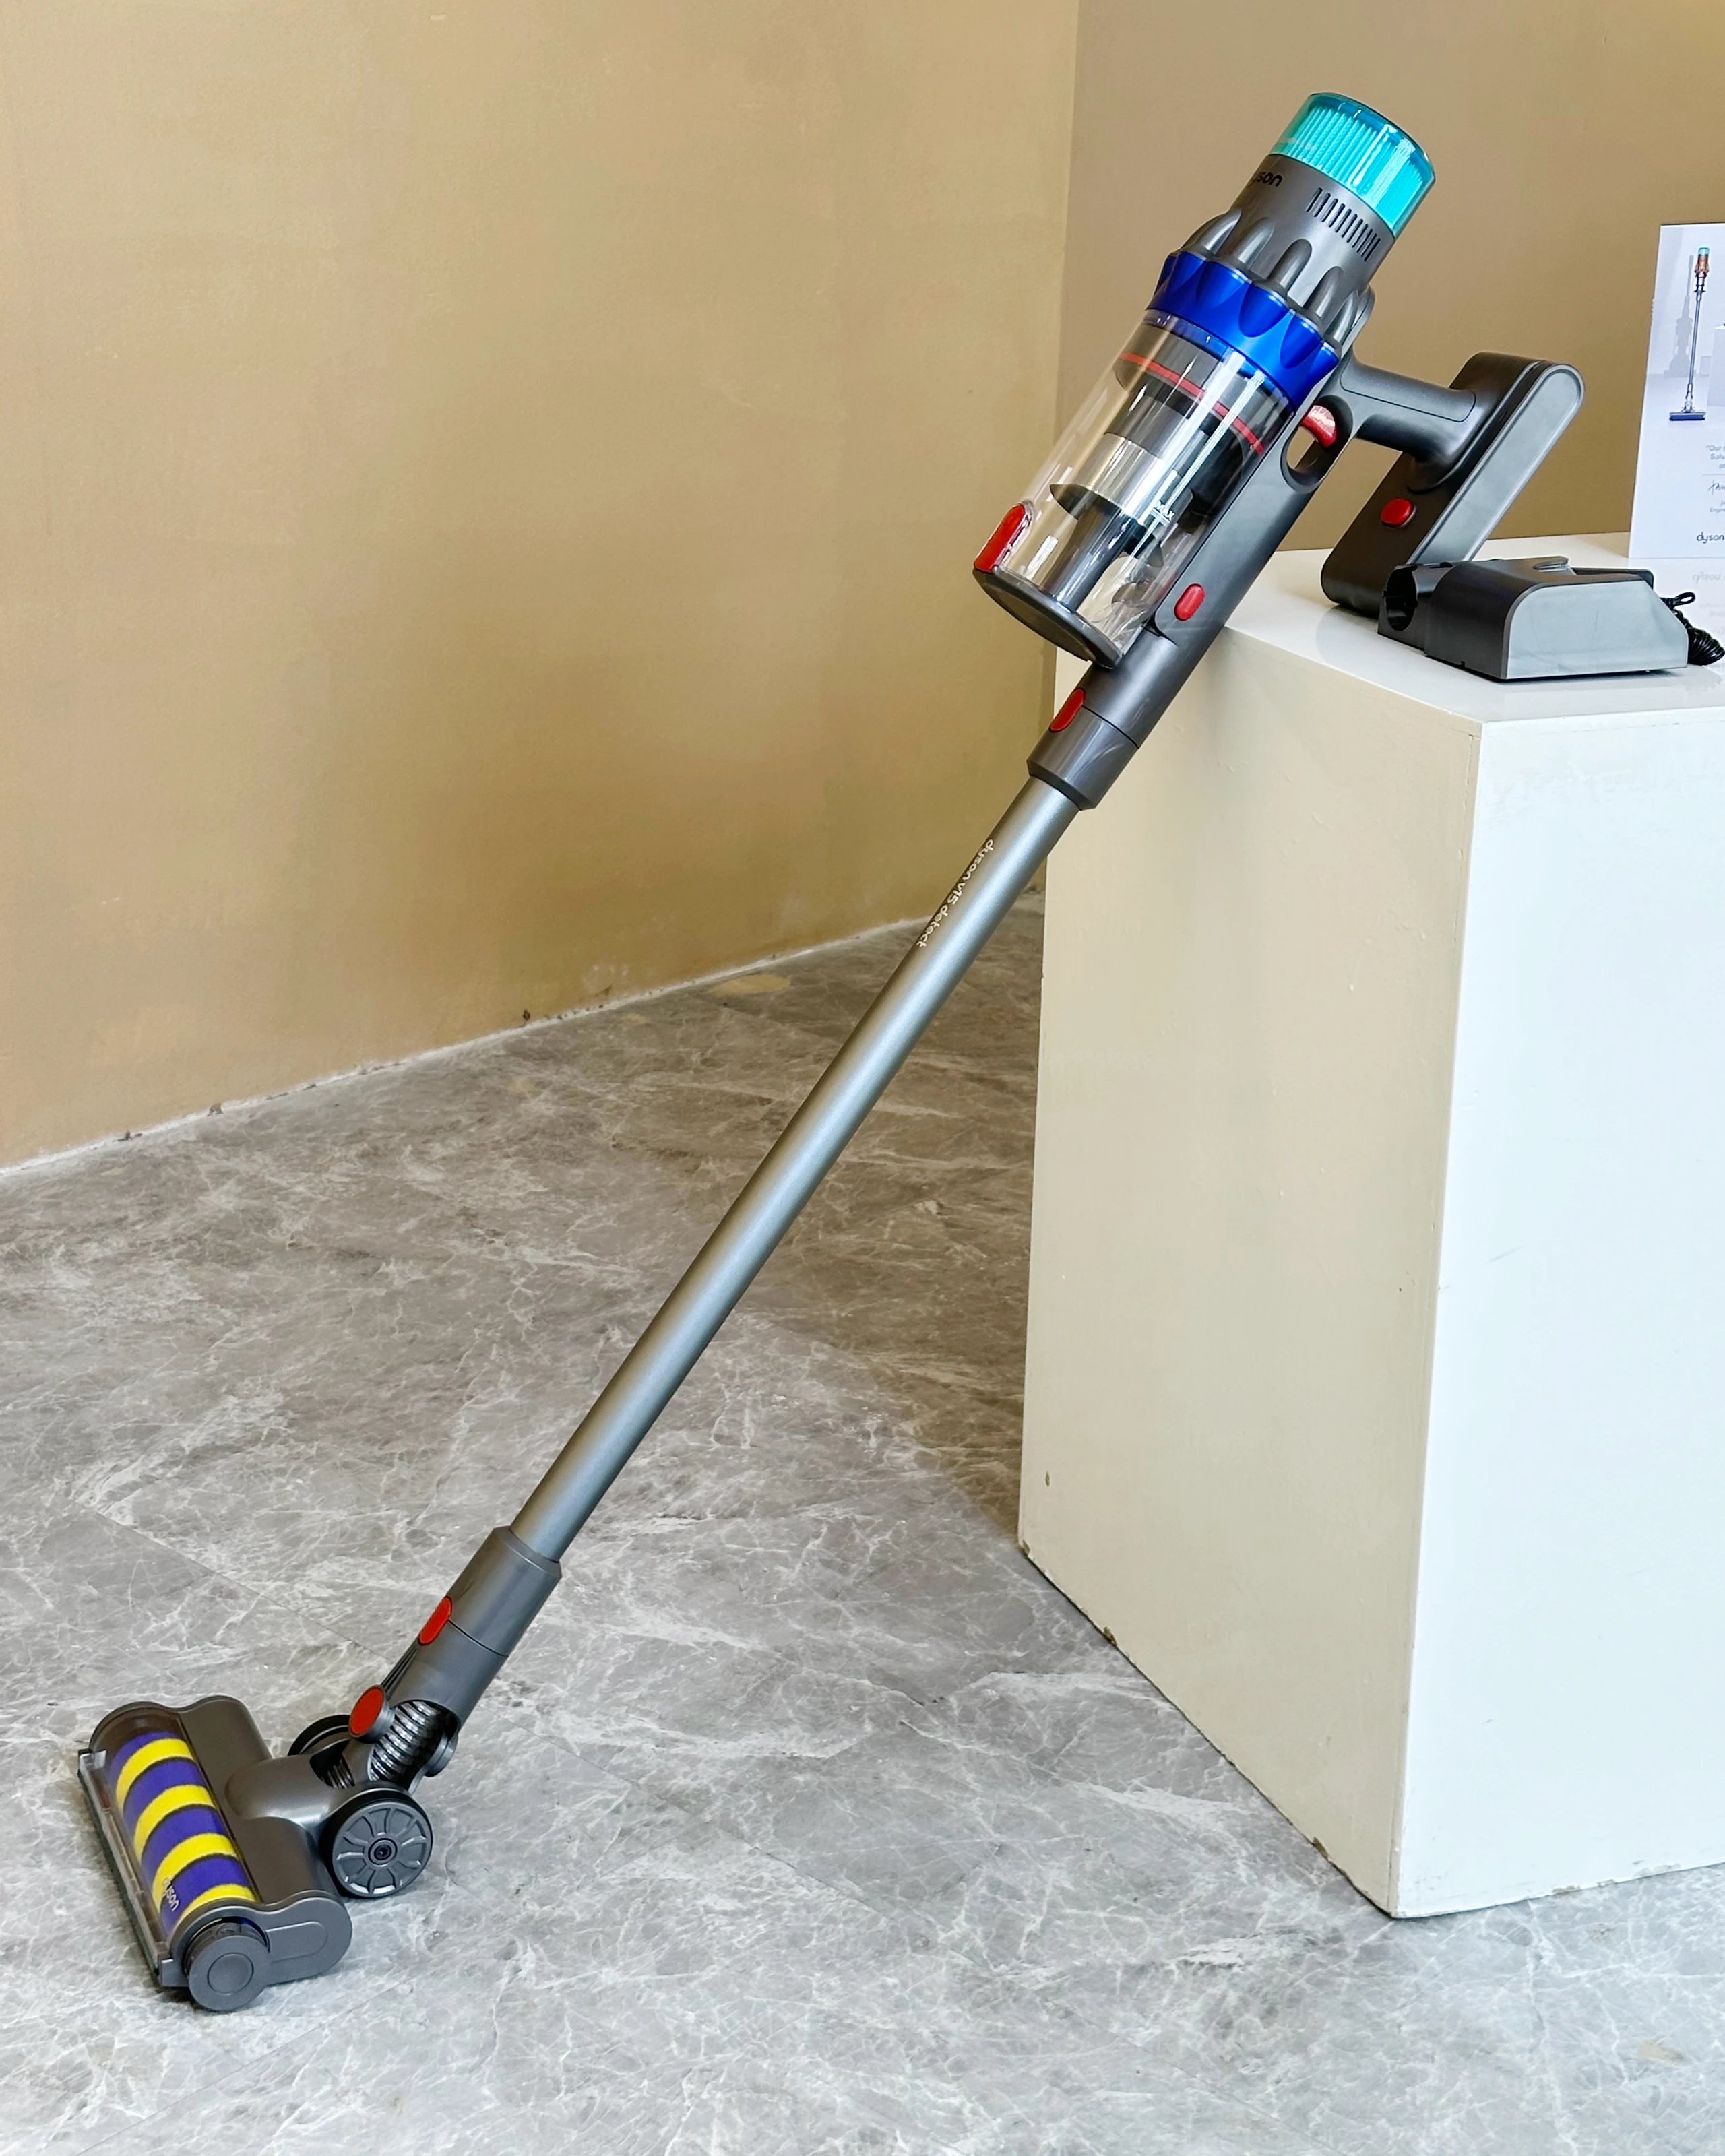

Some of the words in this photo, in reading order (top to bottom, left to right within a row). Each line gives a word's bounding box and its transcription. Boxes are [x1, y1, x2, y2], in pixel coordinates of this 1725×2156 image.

[1248, 171, 1283, 187] son
[1697, 532, 1724, 544] dyson
[962, 839, 994, 881] dyson
[916, 905, 949, 947] detect
